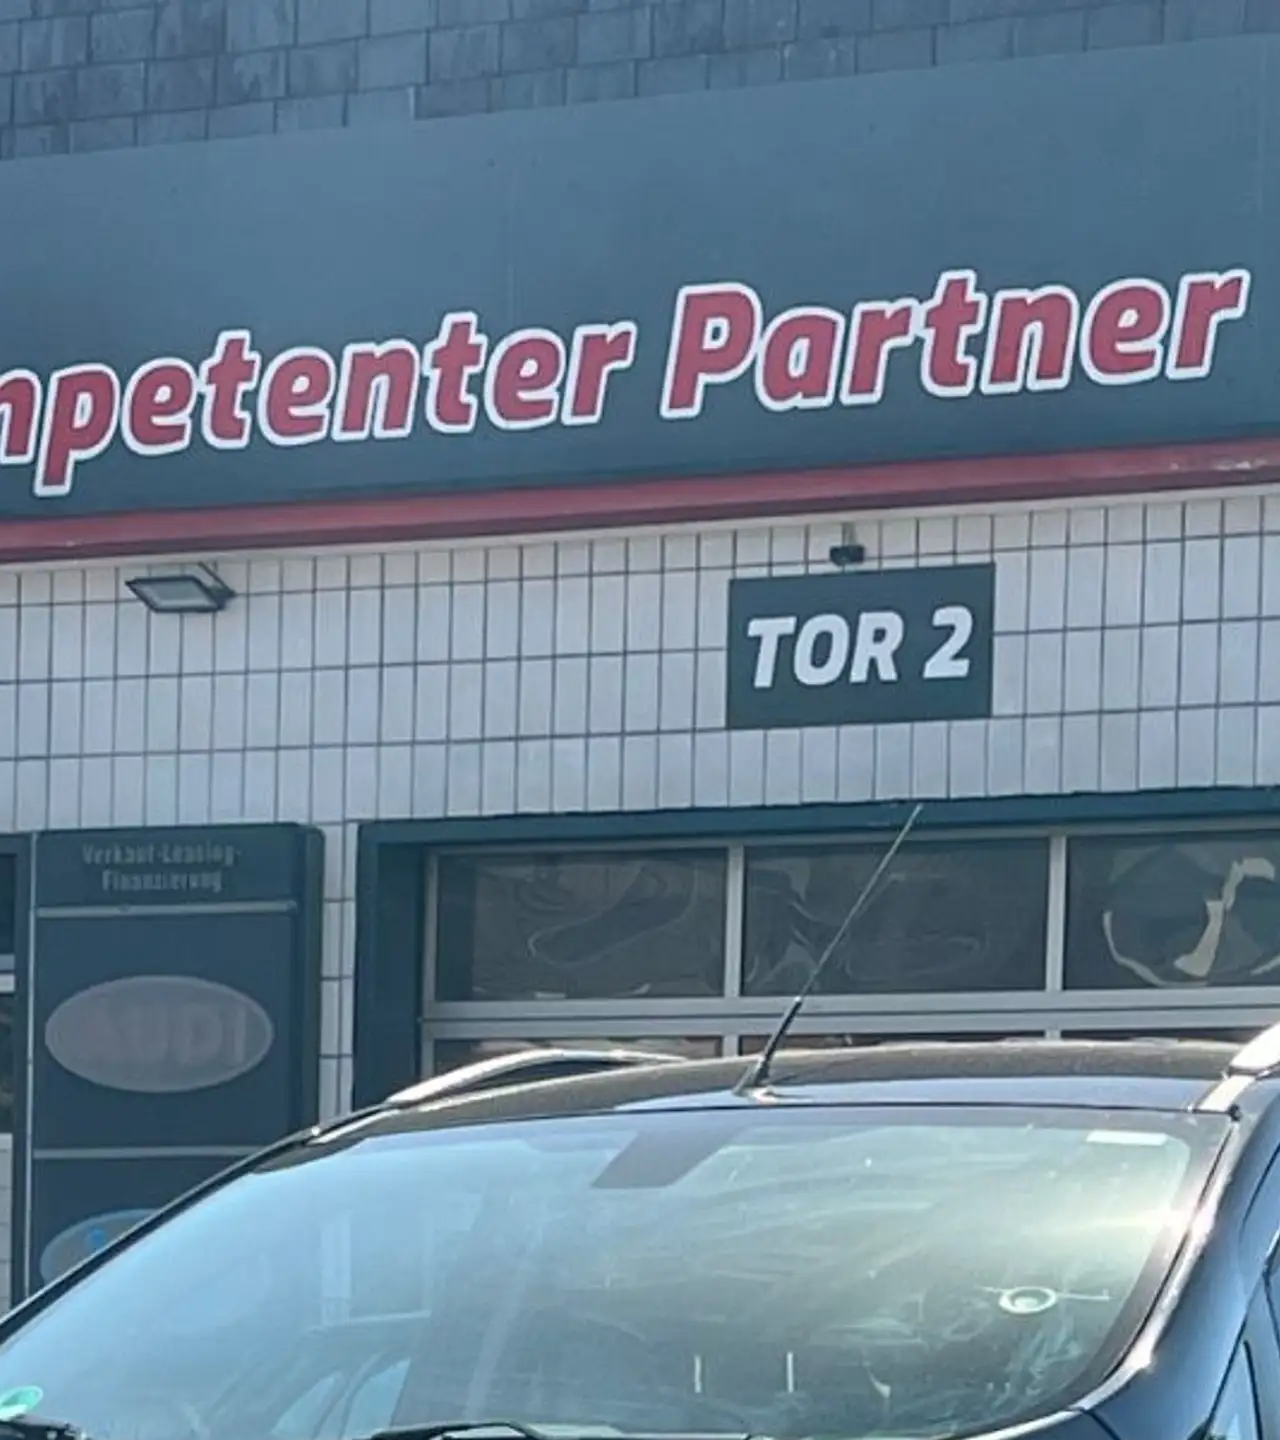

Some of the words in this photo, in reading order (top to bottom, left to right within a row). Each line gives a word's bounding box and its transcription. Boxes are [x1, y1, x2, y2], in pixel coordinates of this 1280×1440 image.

[659, 268, 1251, 421] Partner
[747, 611, 905, 688] TOR
[922, 605, 973, 679] 2
